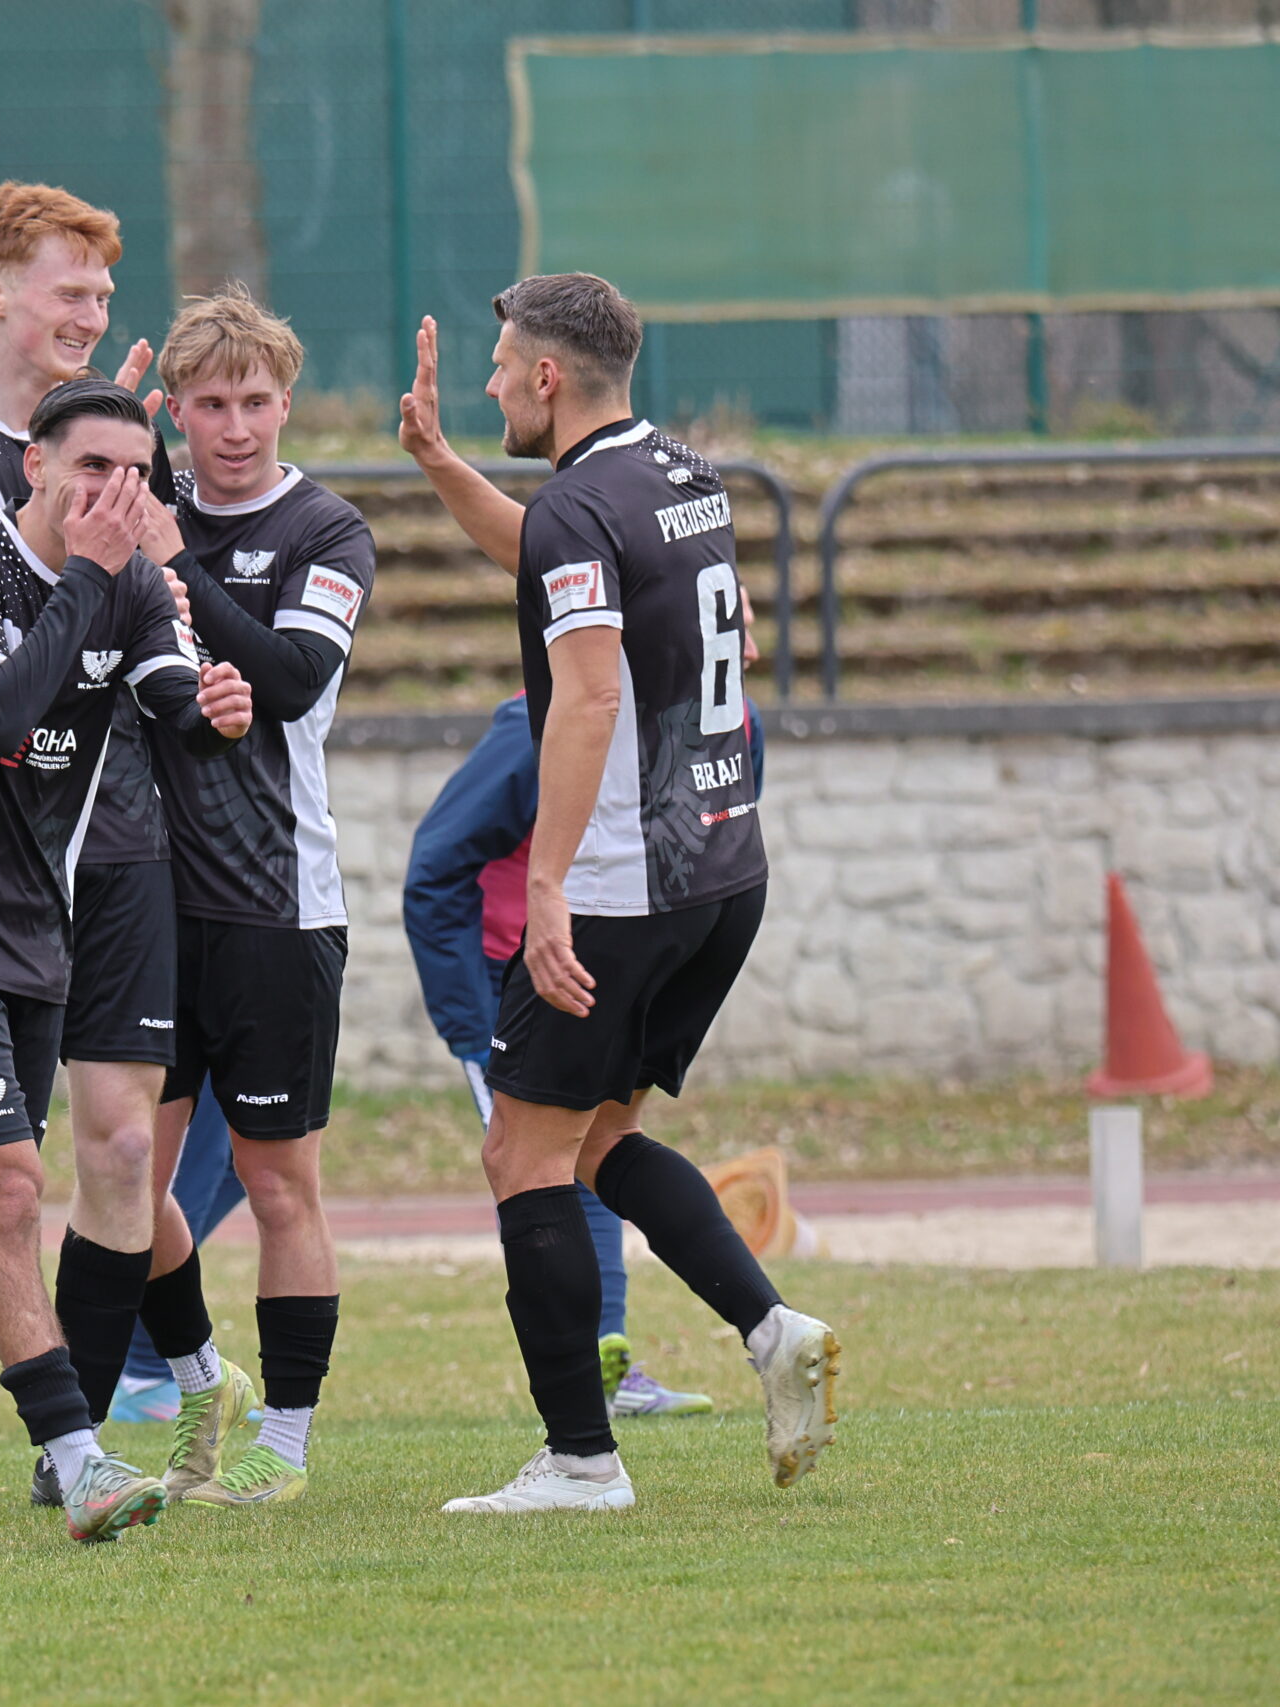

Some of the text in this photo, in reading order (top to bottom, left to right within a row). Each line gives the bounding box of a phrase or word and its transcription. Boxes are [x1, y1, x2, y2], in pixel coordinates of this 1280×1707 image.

[654, 490, 732, 543] PREUSSEN
[310, 575, 354, 602] HWB
[550, 573, 589, 596] HWB
[697, 563, 744, 736] 6
[32, 728, 77, 752] OHA
